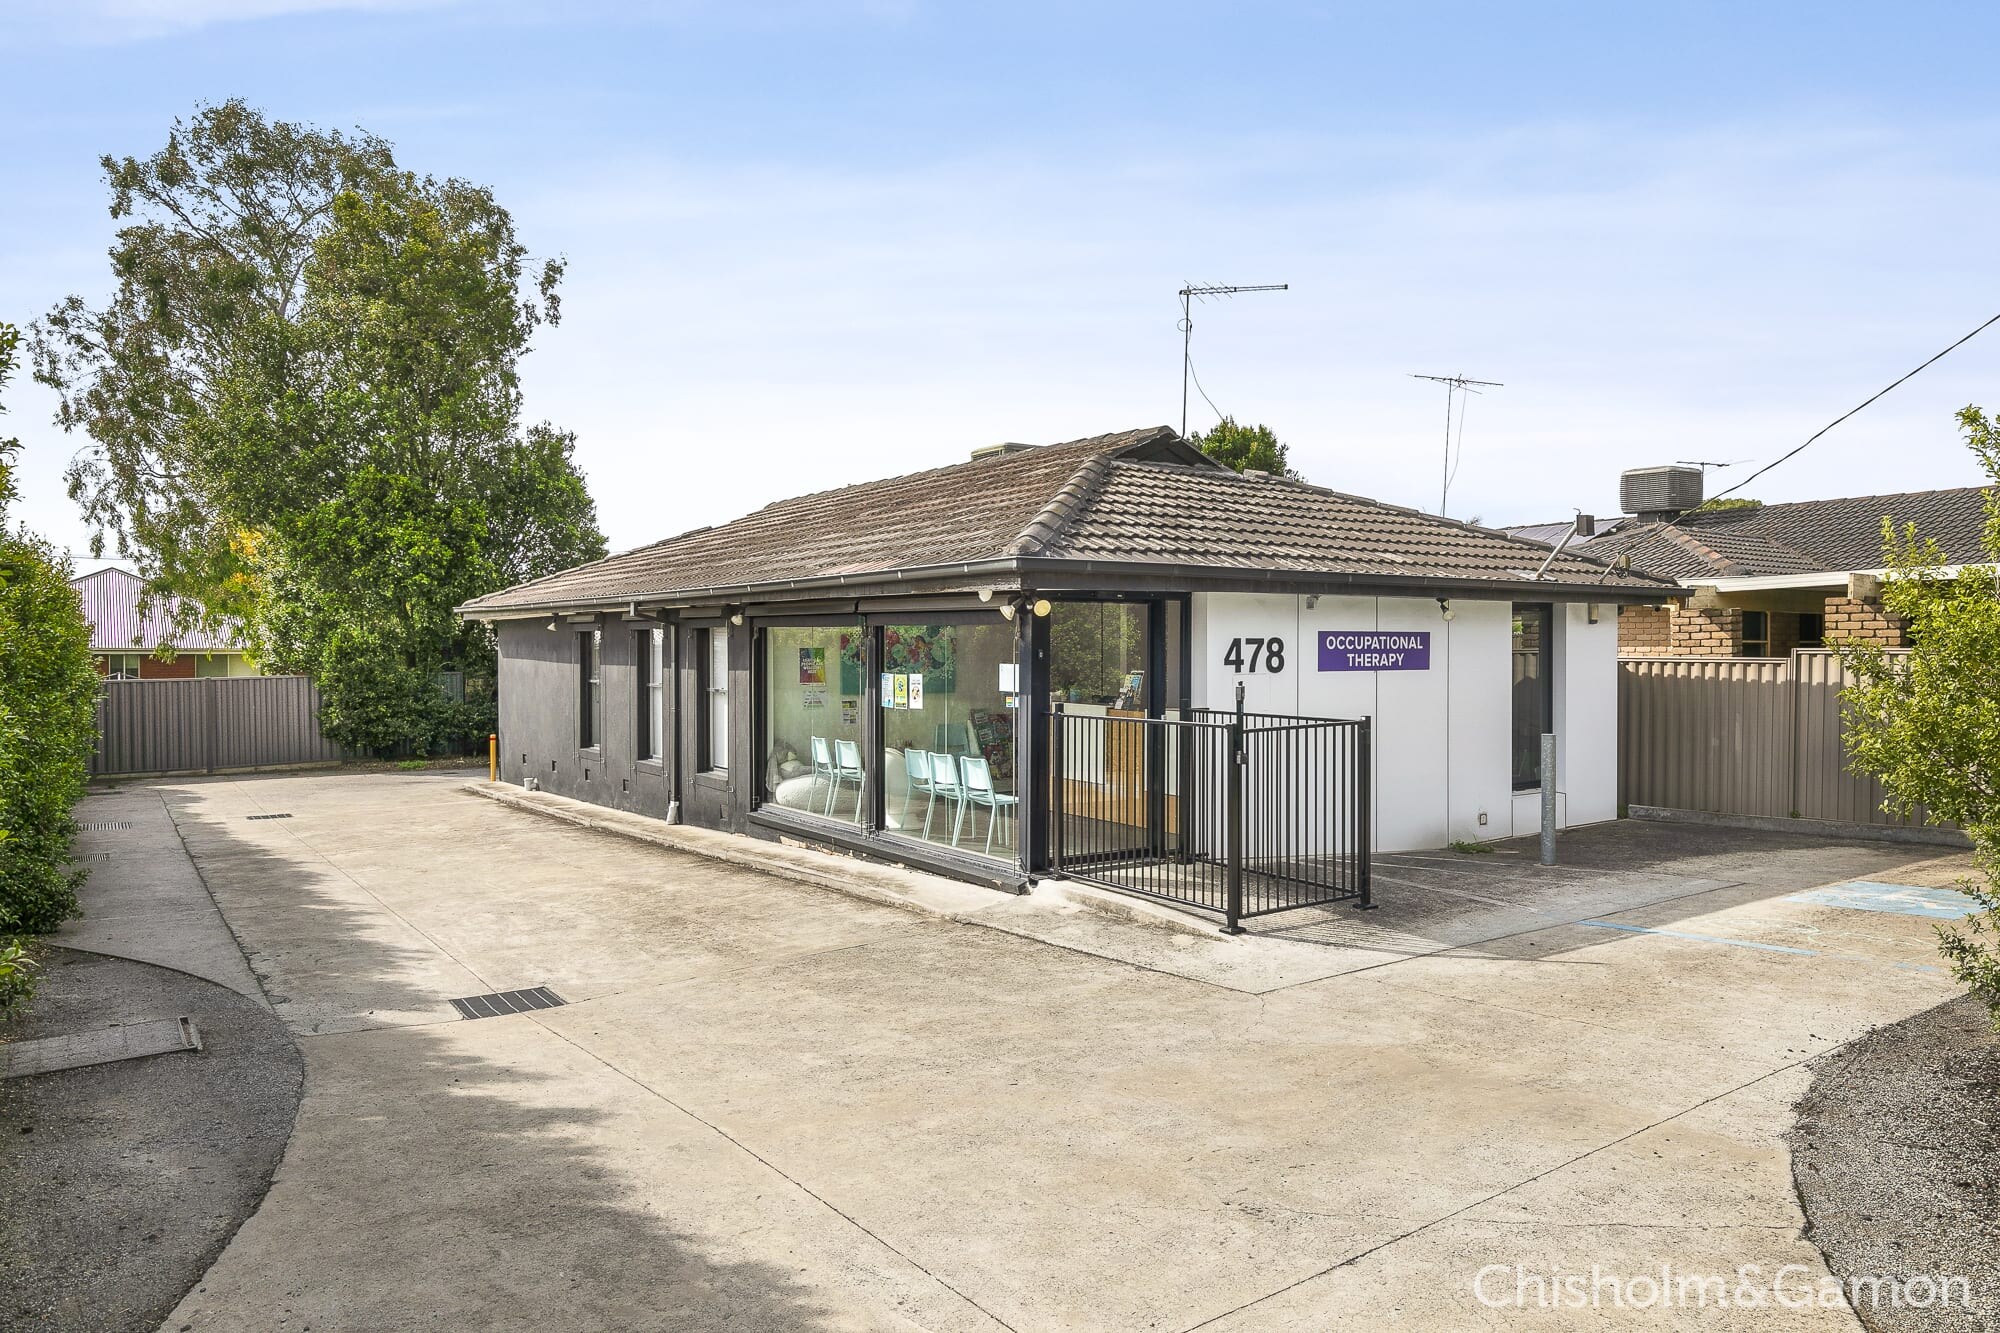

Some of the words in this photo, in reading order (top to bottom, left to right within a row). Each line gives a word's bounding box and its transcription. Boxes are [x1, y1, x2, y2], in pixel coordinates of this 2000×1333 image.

[1326, 636, 1423, 650] OCCUPATIONAL
[1224, 637, 1285, 674] 478
[1347, 653, 1404, 667] THERAPY
